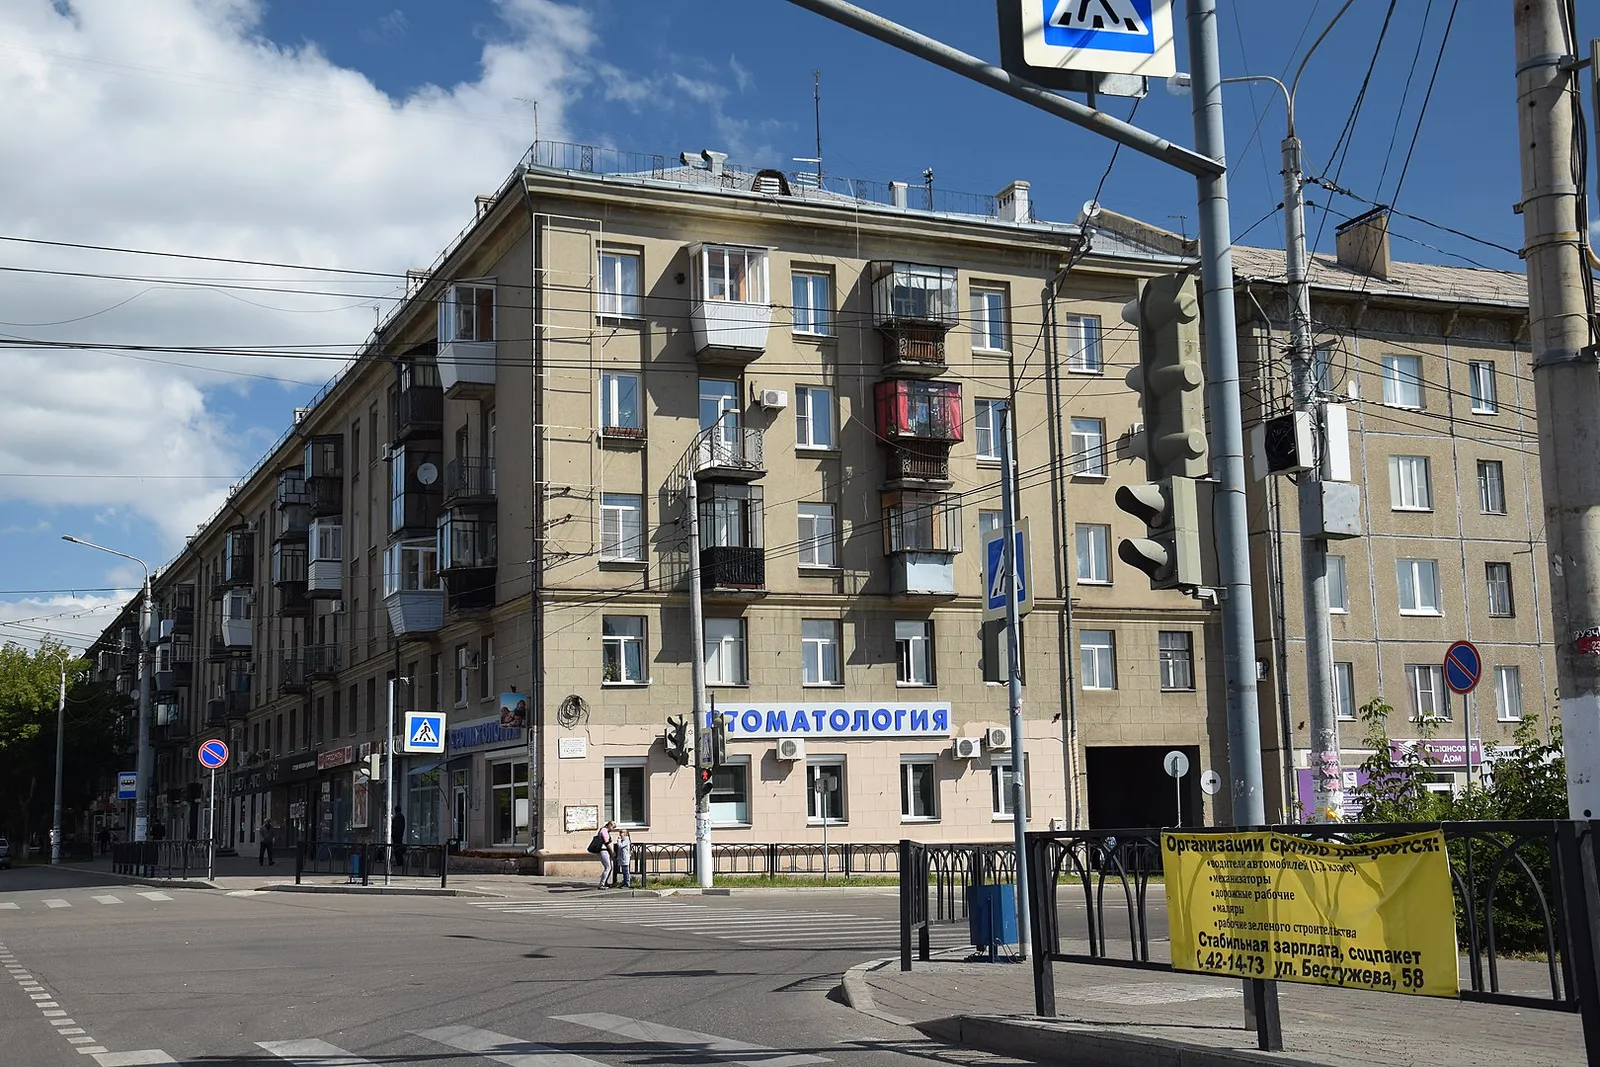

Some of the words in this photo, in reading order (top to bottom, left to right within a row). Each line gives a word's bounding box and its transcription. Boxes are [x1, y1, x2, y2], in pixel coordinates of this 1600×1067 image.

[1442, 753, 1462, 764] Дом
[1166, 835, 1265, 856] Организации
[1269, 837, 1330, 857] срочно
[1211, 859, 1246, 870] водители
[1246, 858, 1310, 872] автомобилей
[1328, 861, 1358, 876] класс)
[1212, 874, 1272, 887] механизаторы
[1215, 888, 1252, 901] дорожные
[1254, 888, 1296, 902] рабочие
[1216, 903, 1245, 916] маляры
[1217, 917, 1247, 931] рабочие
[1247, 920, 1292, 934] зеленого
[1292, 923, 1358, 940] строительства
[1197, 930, 1270, 953] Стабильная
[1272, 939, 1345, 963] зарплата,
[1348, 945, 1422, 966] соцпакет
[1204, 950, 1265, 975] 42-14-73
[1273, 959, 1298, 979] ул.
[1301, 957, 1398, 990] Бестужева,
[1401, 966, 1425, 989] 58
